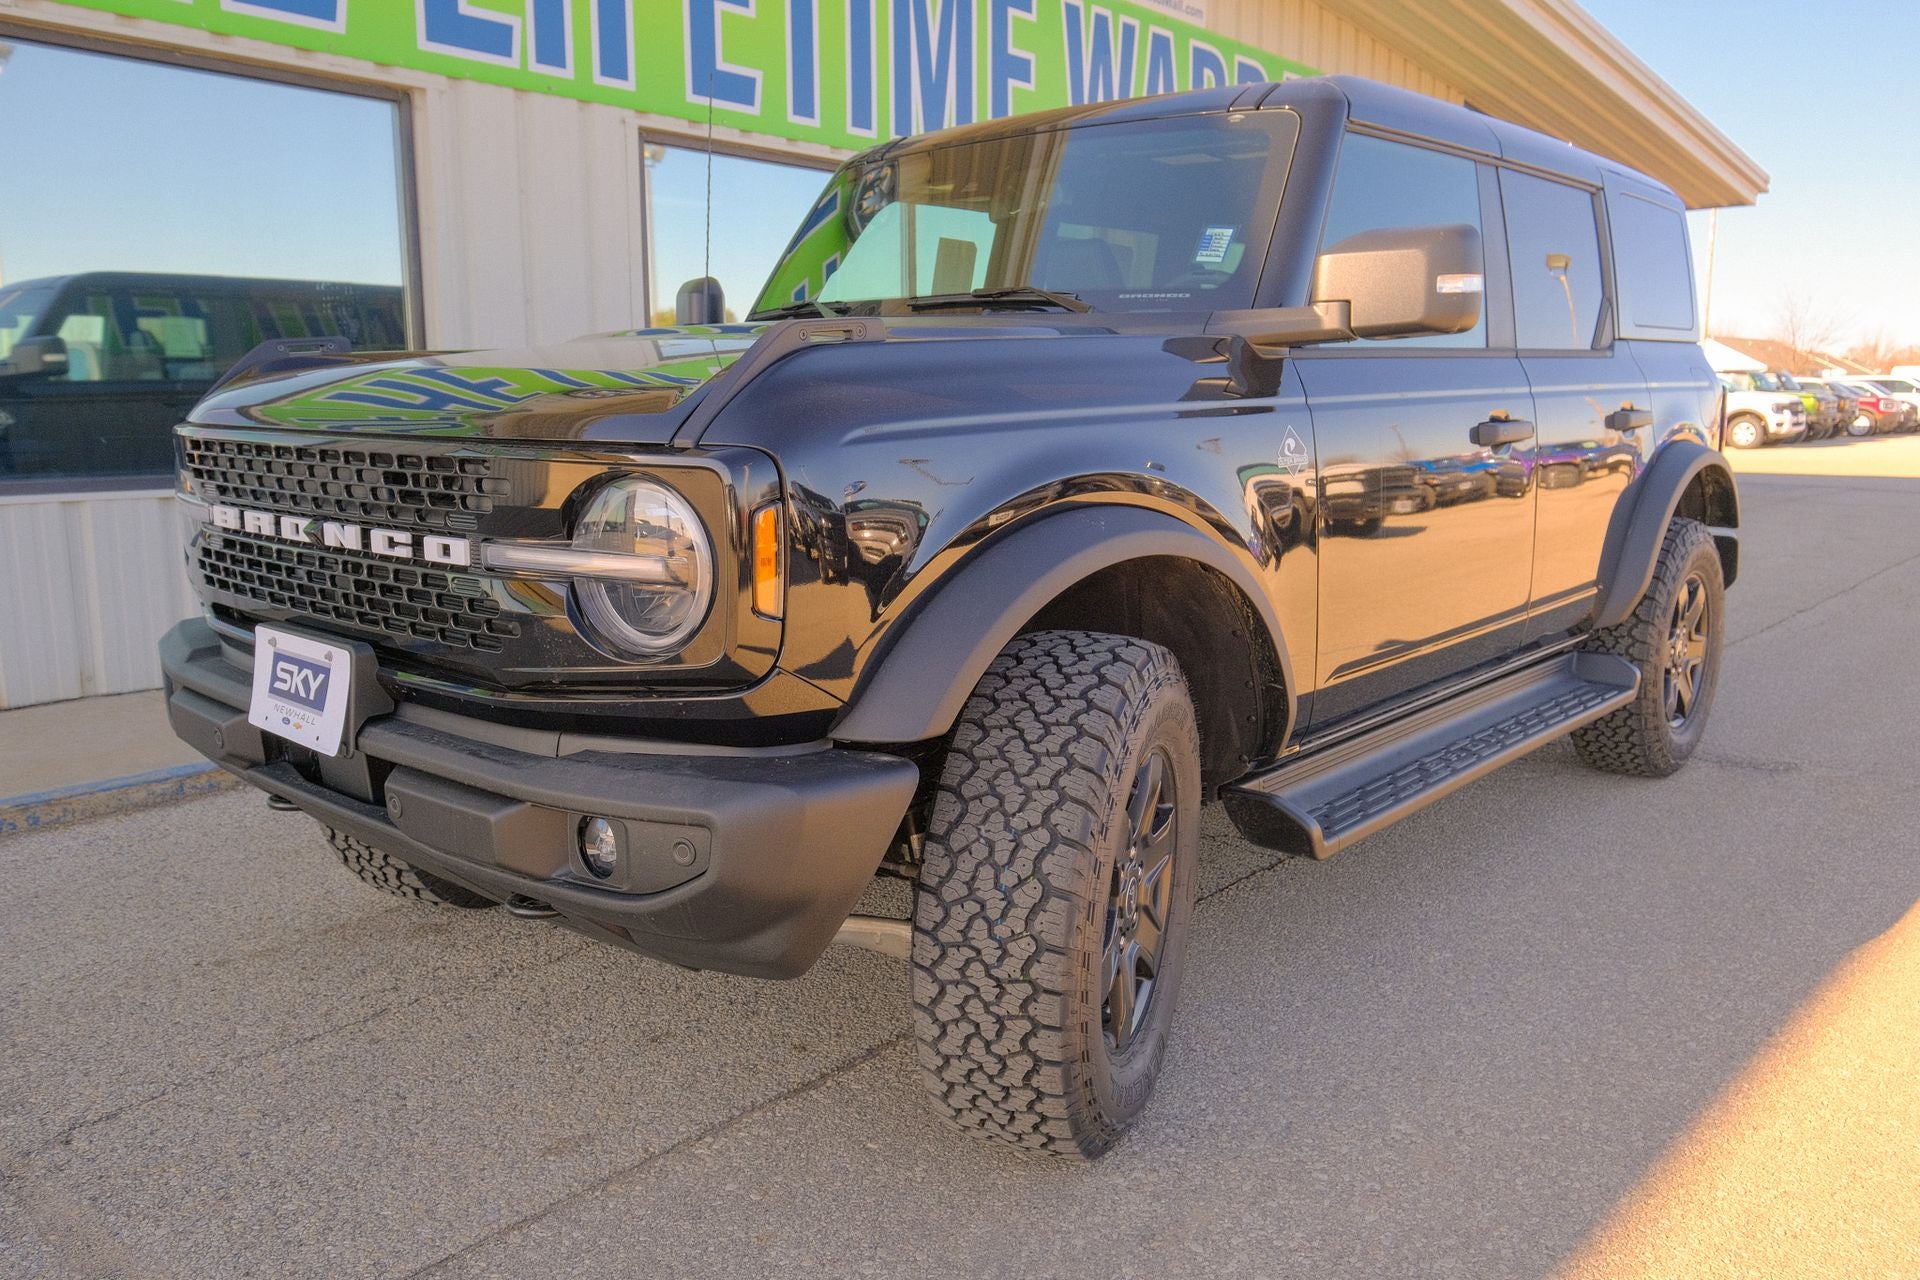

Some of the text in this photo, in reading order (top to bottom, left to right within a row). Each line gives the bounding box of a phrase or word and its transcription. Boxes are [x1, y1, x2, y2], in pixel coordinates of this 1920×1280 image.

[415, 0, 1037, 138] ETIME
[212, 504, 471, 567] BRONCO
[273, 661, 325, 700] SKY
[273, 703, 317, 726] NEWHALL
